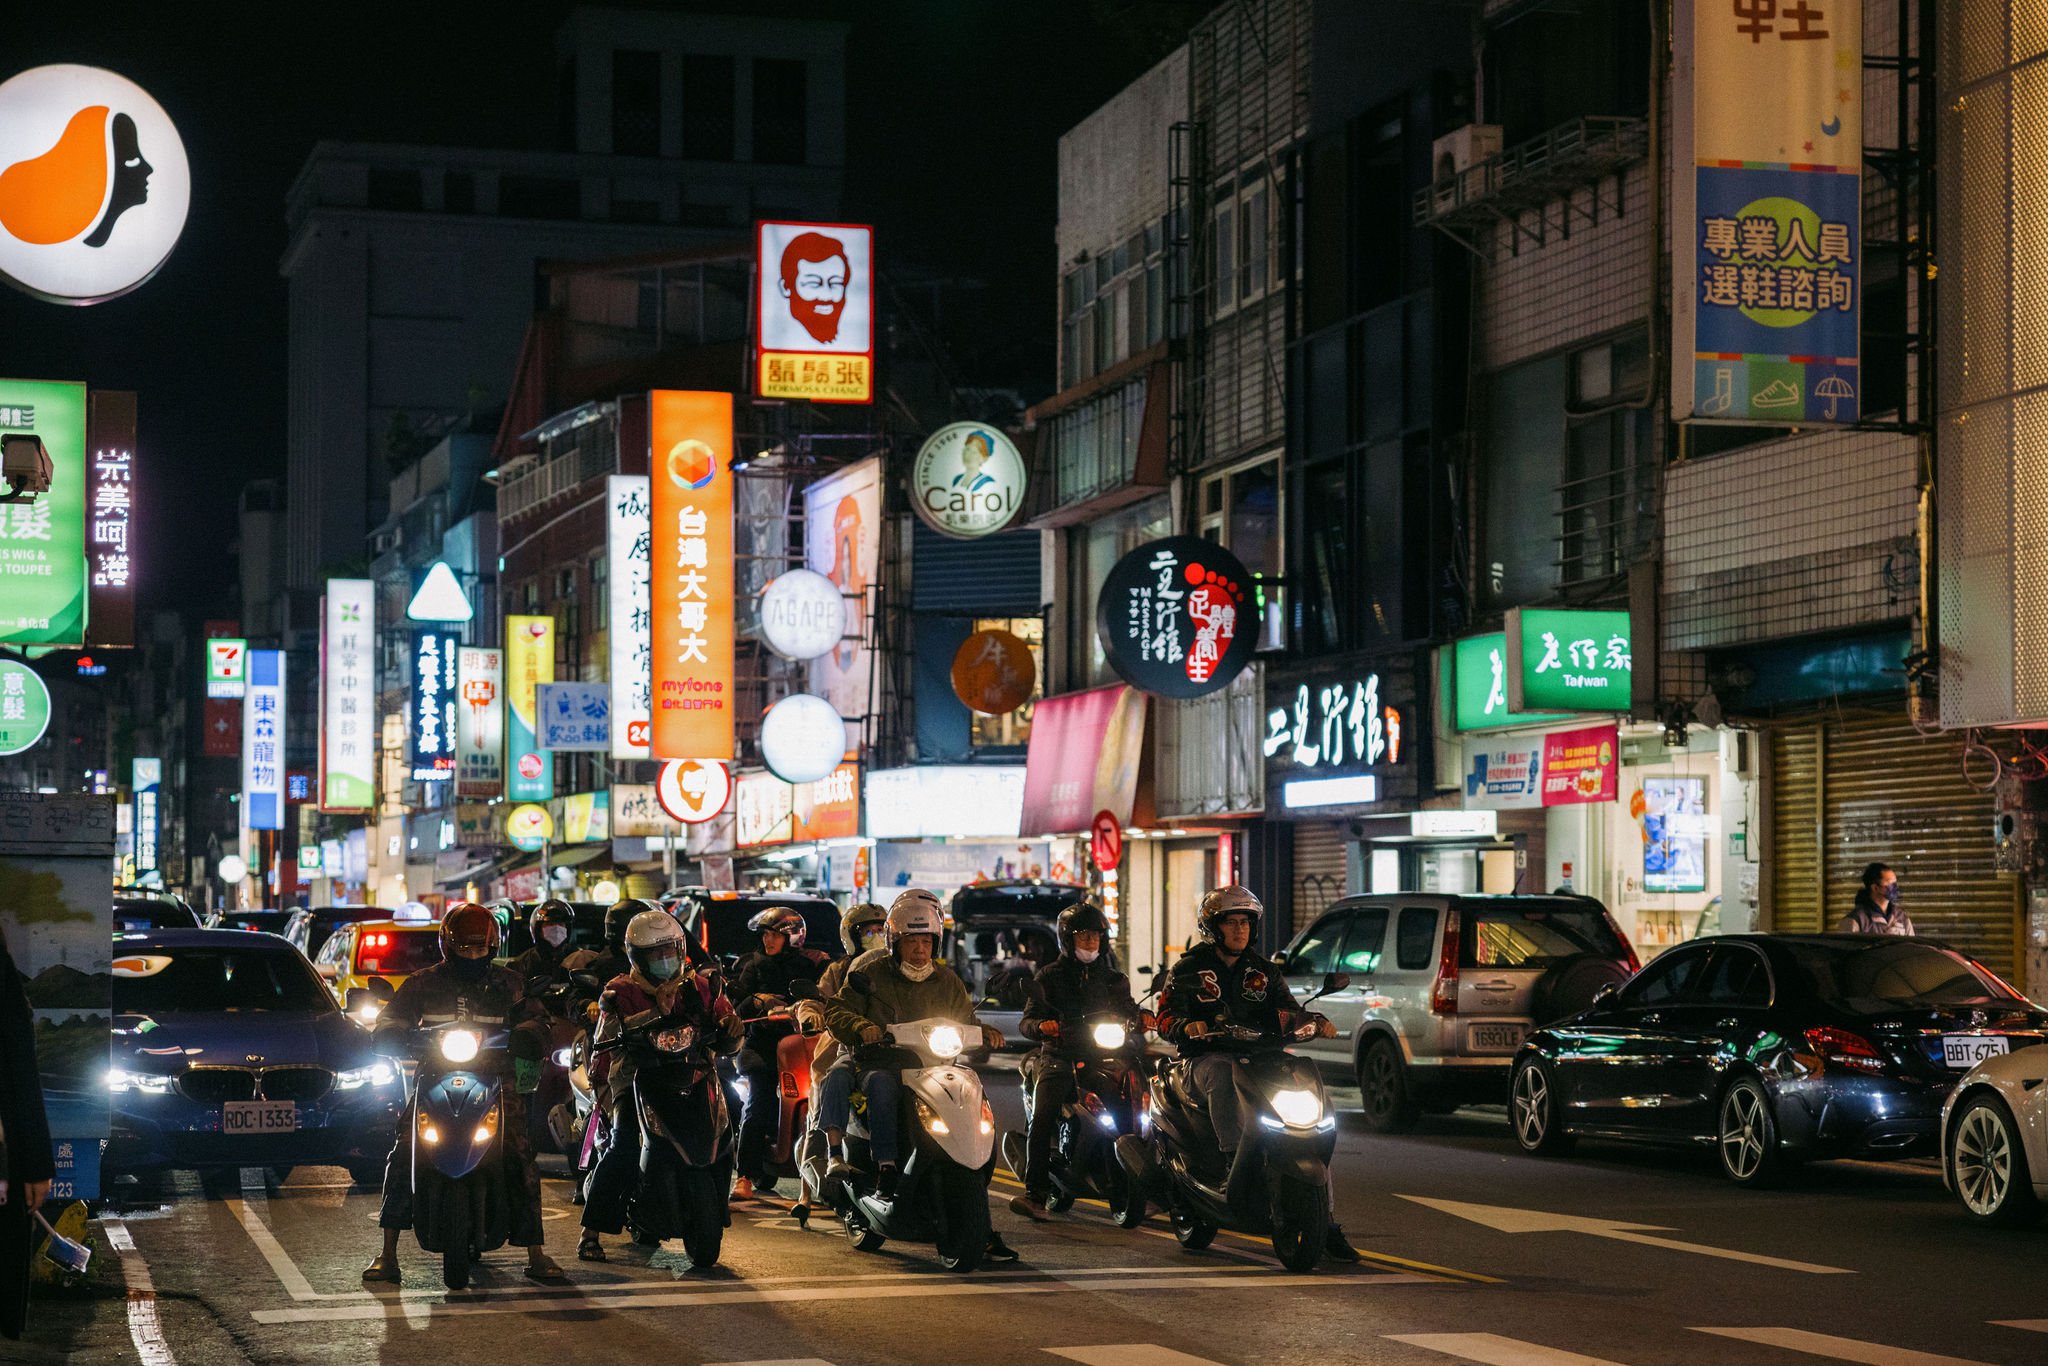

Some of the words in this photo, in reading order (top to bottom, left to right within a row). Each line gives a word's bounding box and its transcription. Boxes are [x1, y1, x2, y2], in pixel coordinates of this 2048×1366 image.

[1703, 217, 1852, 263] 專業人員
[1703, 266, 1852, 311] 選鞋諮詢
[924, 486, 1011, 512] Carol
[5, 564, 52, 576] TOUPEE
[12, 549, 35, 561] WIG
[37, 550, 46, 561] &
[677, 504, 708, 664] 台灣大哥大
[772, 599, 835, 629] AGAPE
[1140, 587, 1152, 661] MASSAGE
[1535, 631, 1632, 673] 老行家
[662, 678, 723, 694] myfone
[1563, 674, 1608, 688] Taiwan
